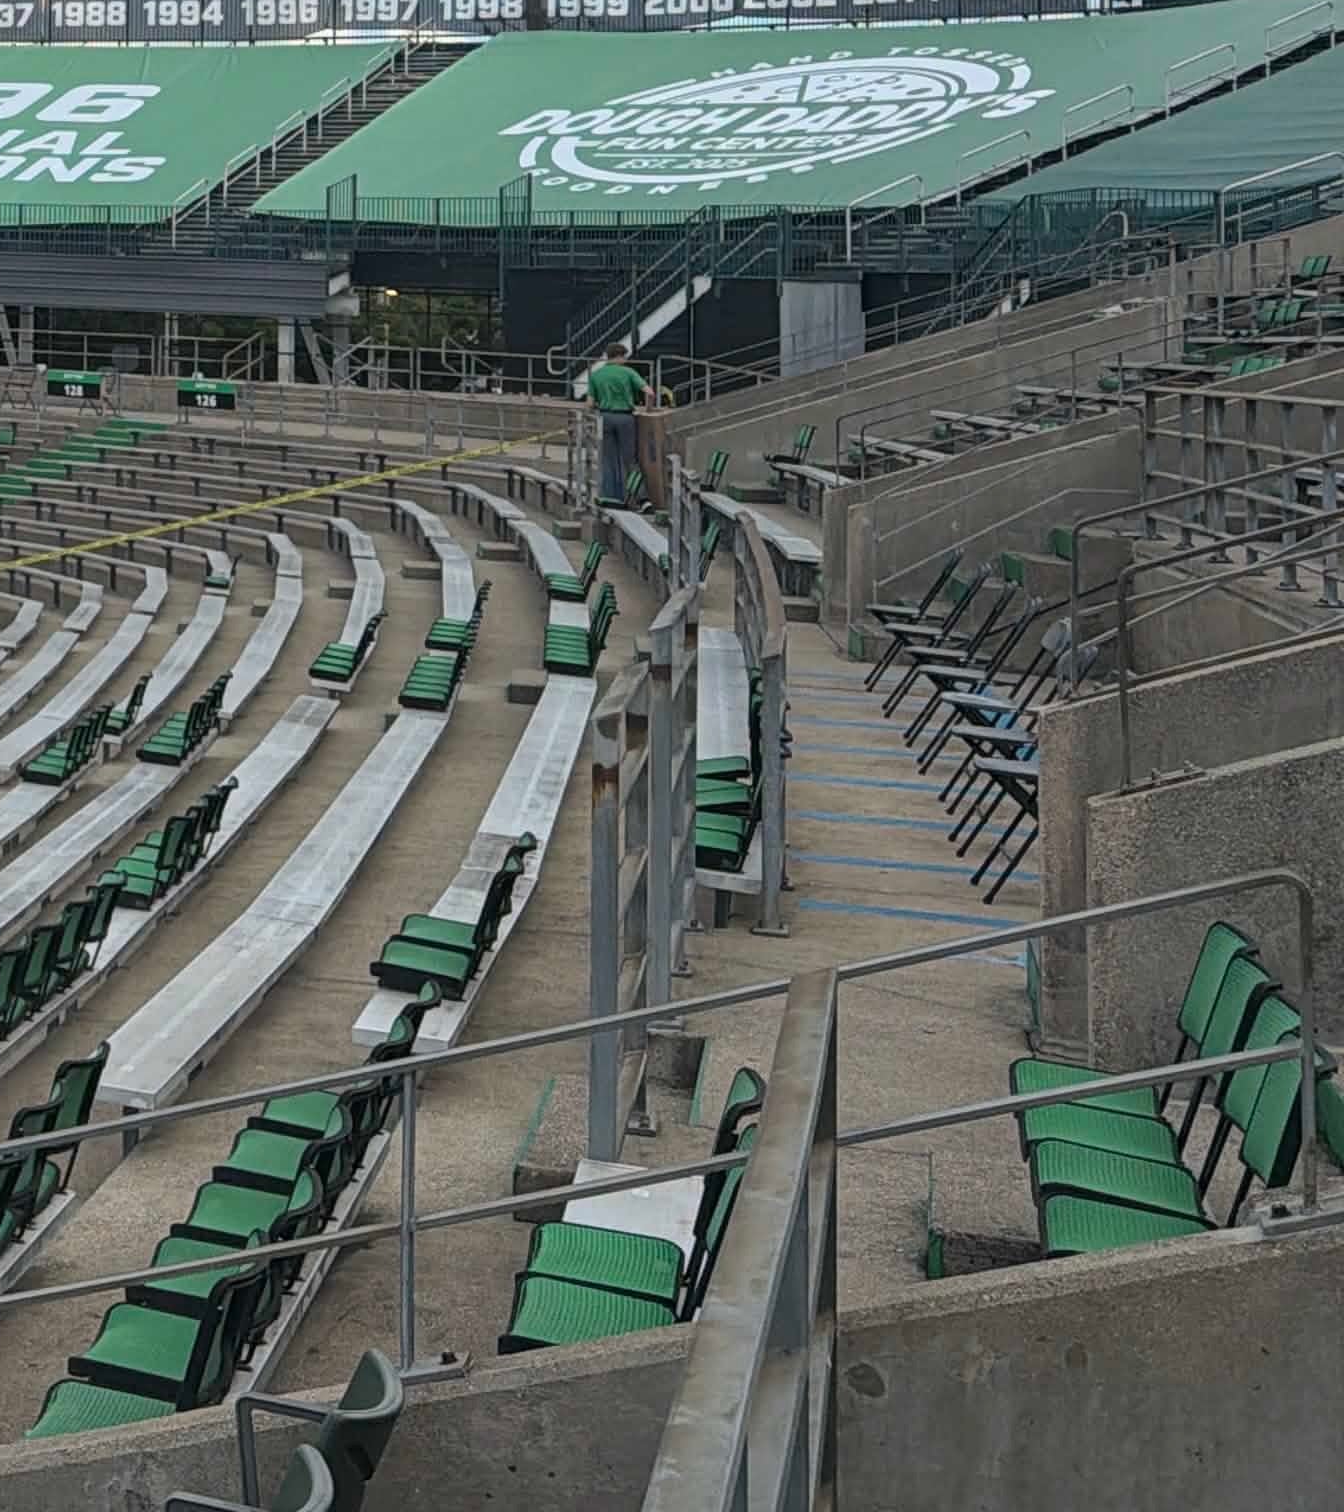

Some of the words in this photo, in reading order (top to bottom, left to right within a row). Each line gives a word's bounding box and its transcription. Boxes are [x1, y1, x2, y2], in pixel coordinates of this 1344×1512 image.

[51, 0, 127, 27] 1988
[143, 0, 224, 27] 1994
[497, 106, 746, 135] DOUGH
[733, 88, 1057, 134] DADDY'S
[596, 136, 691, 151] FUN
